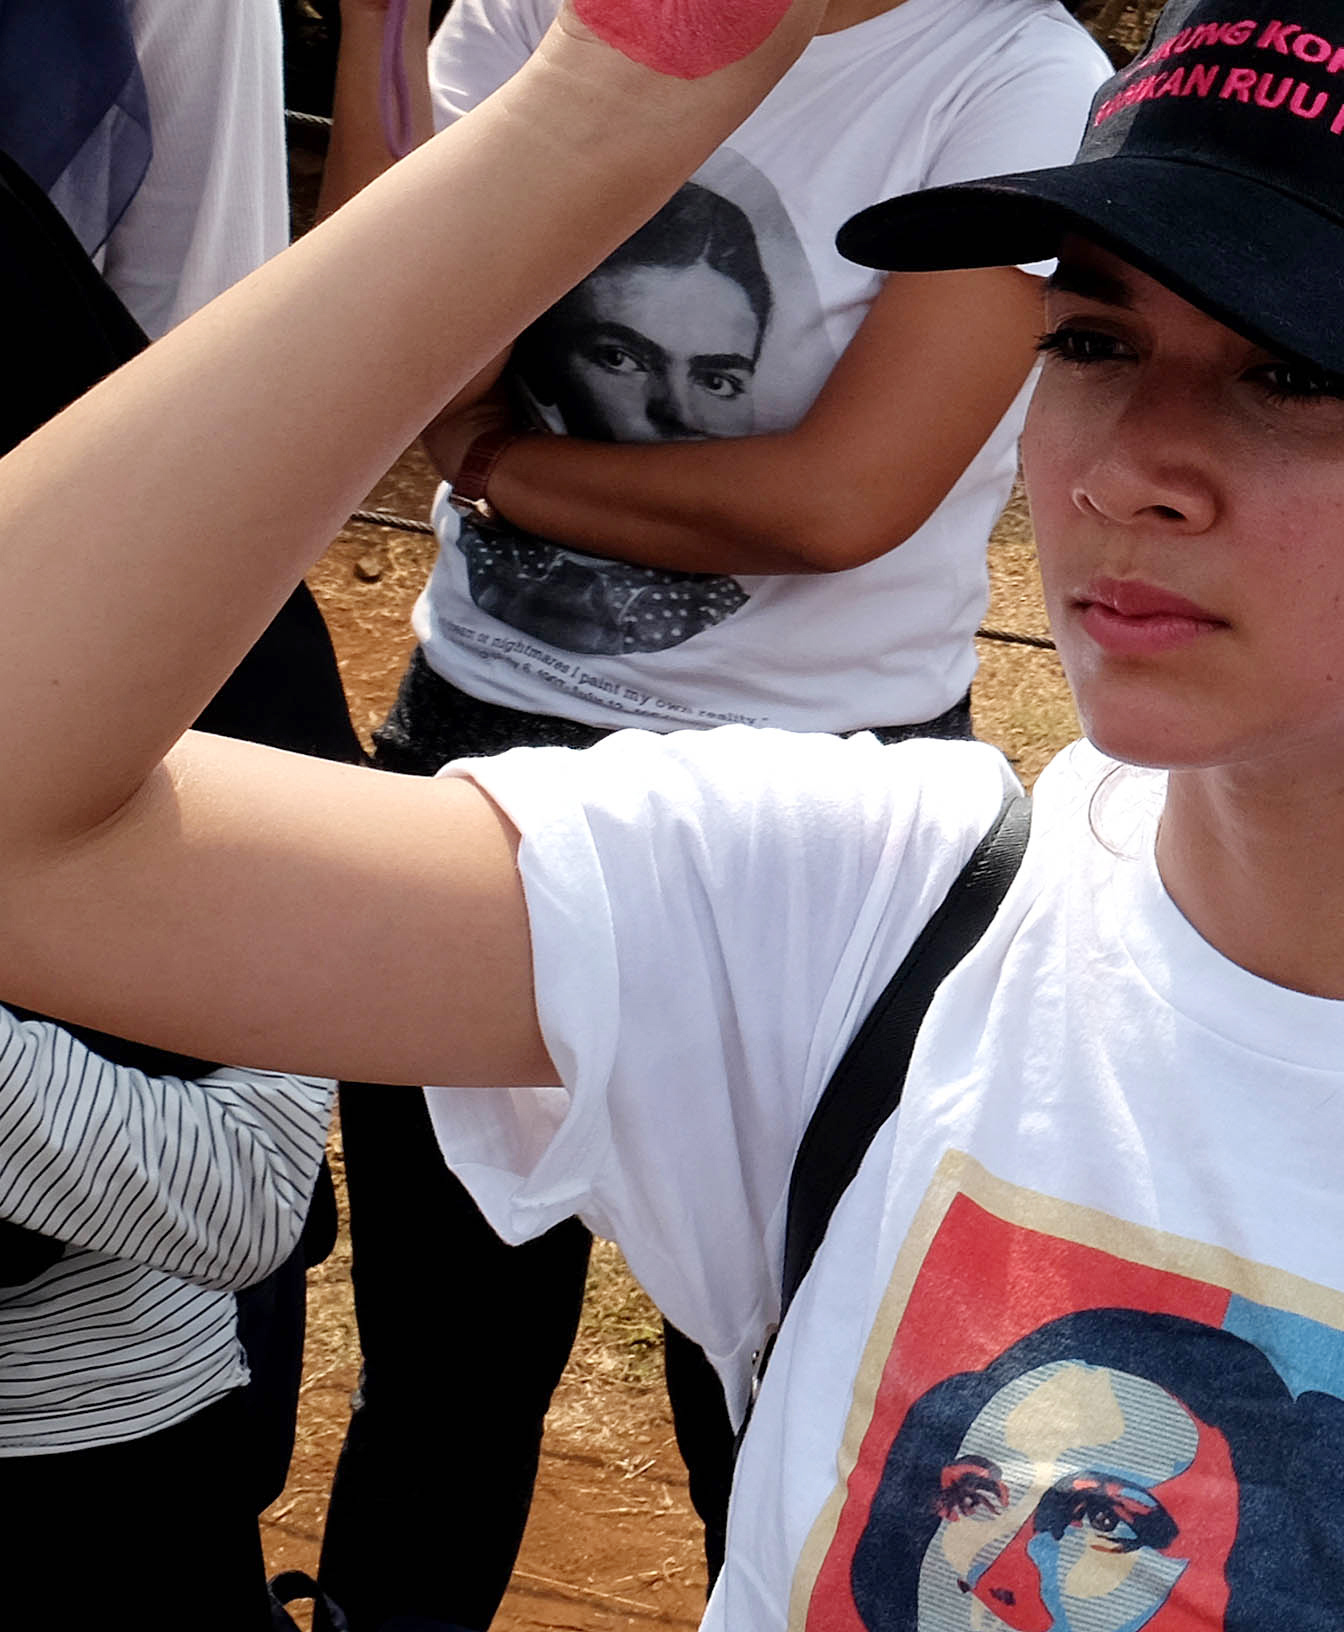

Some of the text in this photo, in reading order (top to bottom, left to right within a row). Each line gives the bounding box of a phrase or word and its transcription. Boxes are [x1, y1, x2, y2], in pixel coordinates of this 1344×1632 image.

[1218, 67, 1328, 120] RUU
[490, 636, 572, 675] nightmares
[578, 671, 621, 696] paint
[622, 685, 652, 706] my
